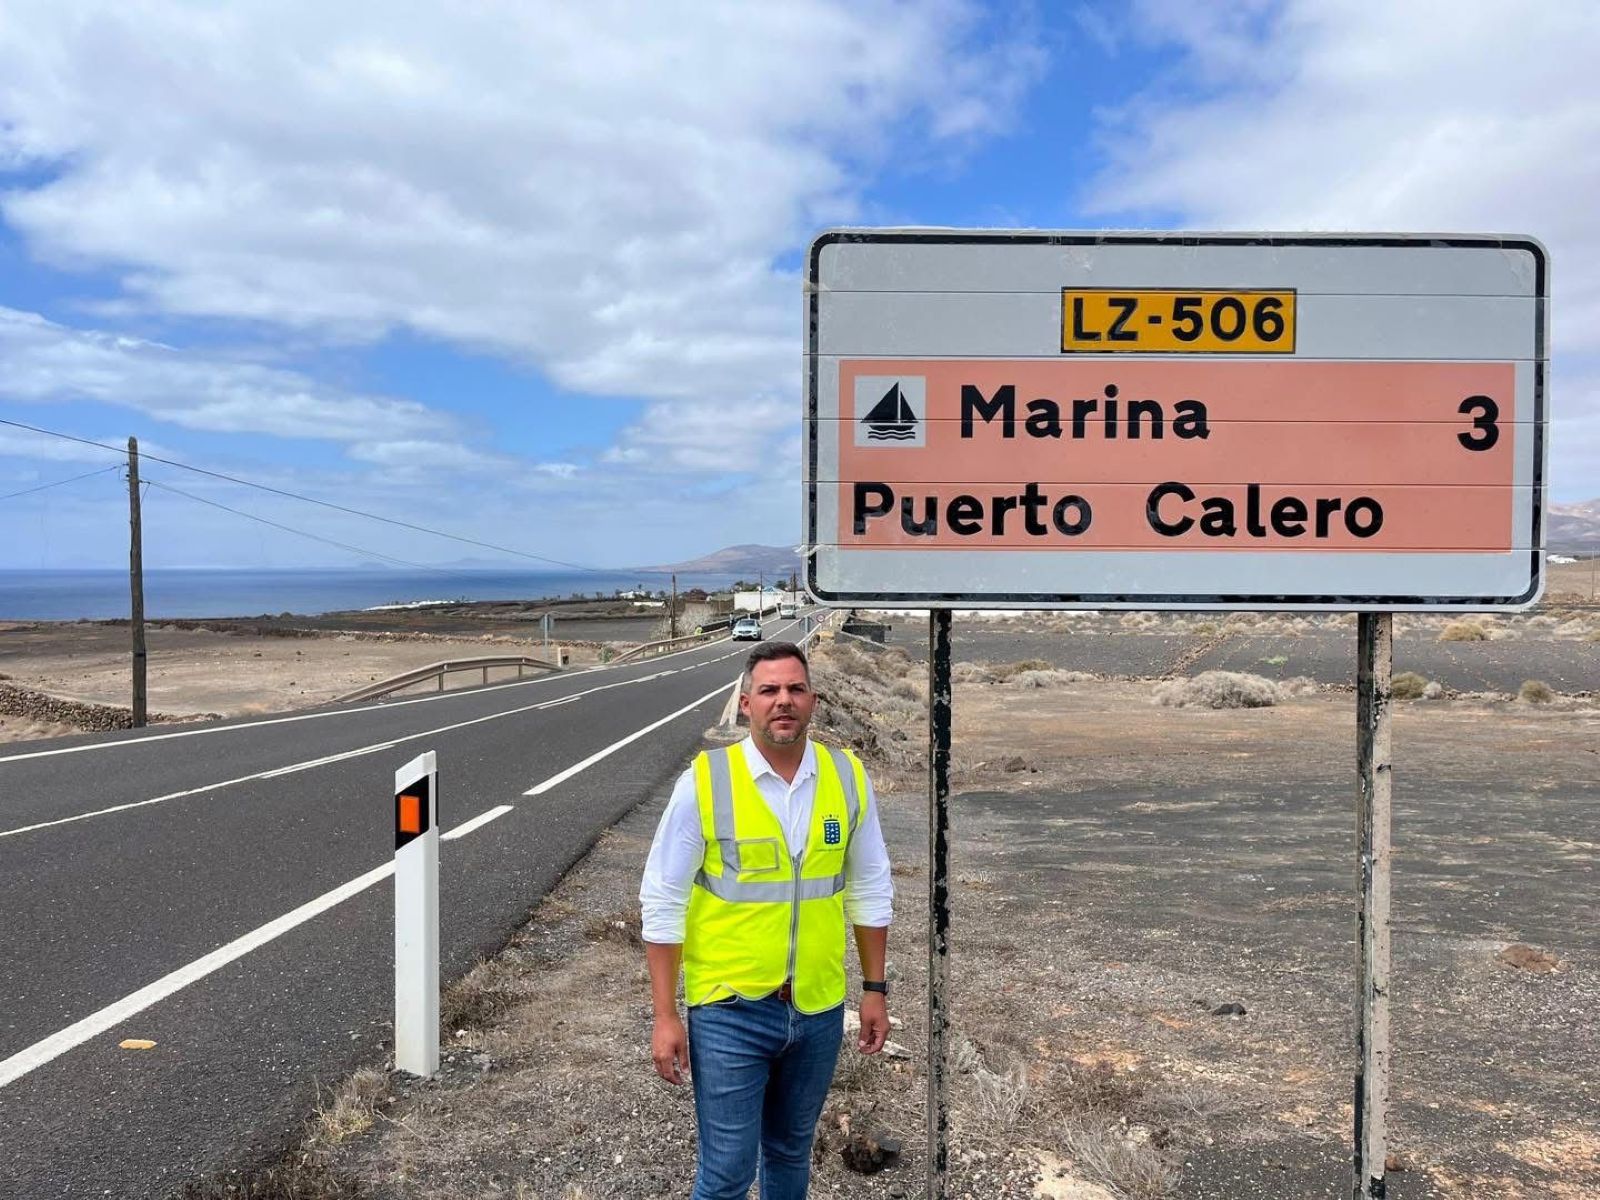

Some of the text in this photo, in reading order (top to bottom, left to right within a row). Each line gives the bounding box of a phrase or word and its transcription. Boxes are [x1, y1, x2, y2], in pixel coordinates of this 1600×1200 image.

[1072, 296, 1285, 342] LZ-506
[961, 384, 1500, 452] Marina 3
[853, 482, 1385, 538] Puerto Calero
